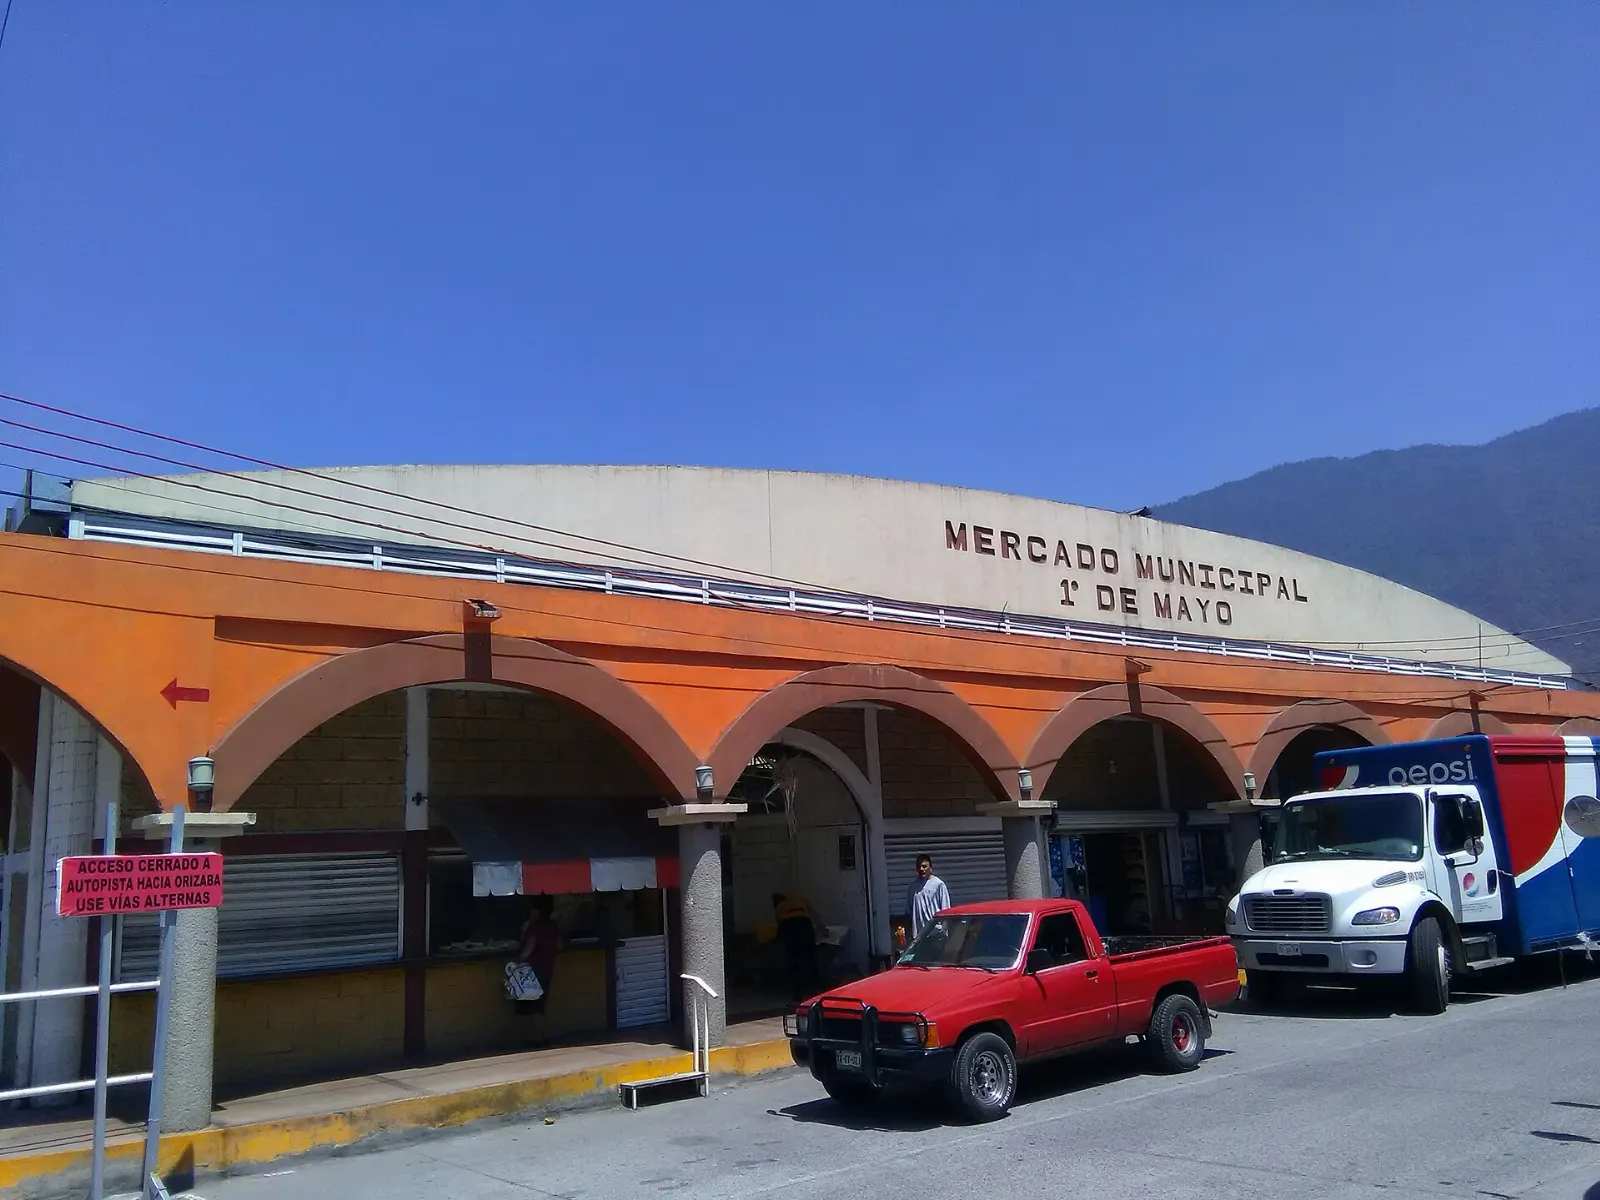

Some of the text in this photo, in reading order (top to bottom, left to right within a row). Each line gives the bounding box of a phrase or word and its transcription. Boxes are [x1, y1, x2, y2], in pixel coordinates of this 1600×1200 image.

[945, 519, 1308, 603] MERCADO MUNICIPAL
[1096, 584, 1138, 616] DE
[1153, 592, 1233, 626] MAYO
[1388, 754, 1474, 785] pepsi
[77, 857, 211, 874] ACCESO CERRADO A
[66, 873, 221, 893] AUTOPISTA HACIA ORIZABA
[76, 891, 210, 912] USE VÍAS ALTERNAS
